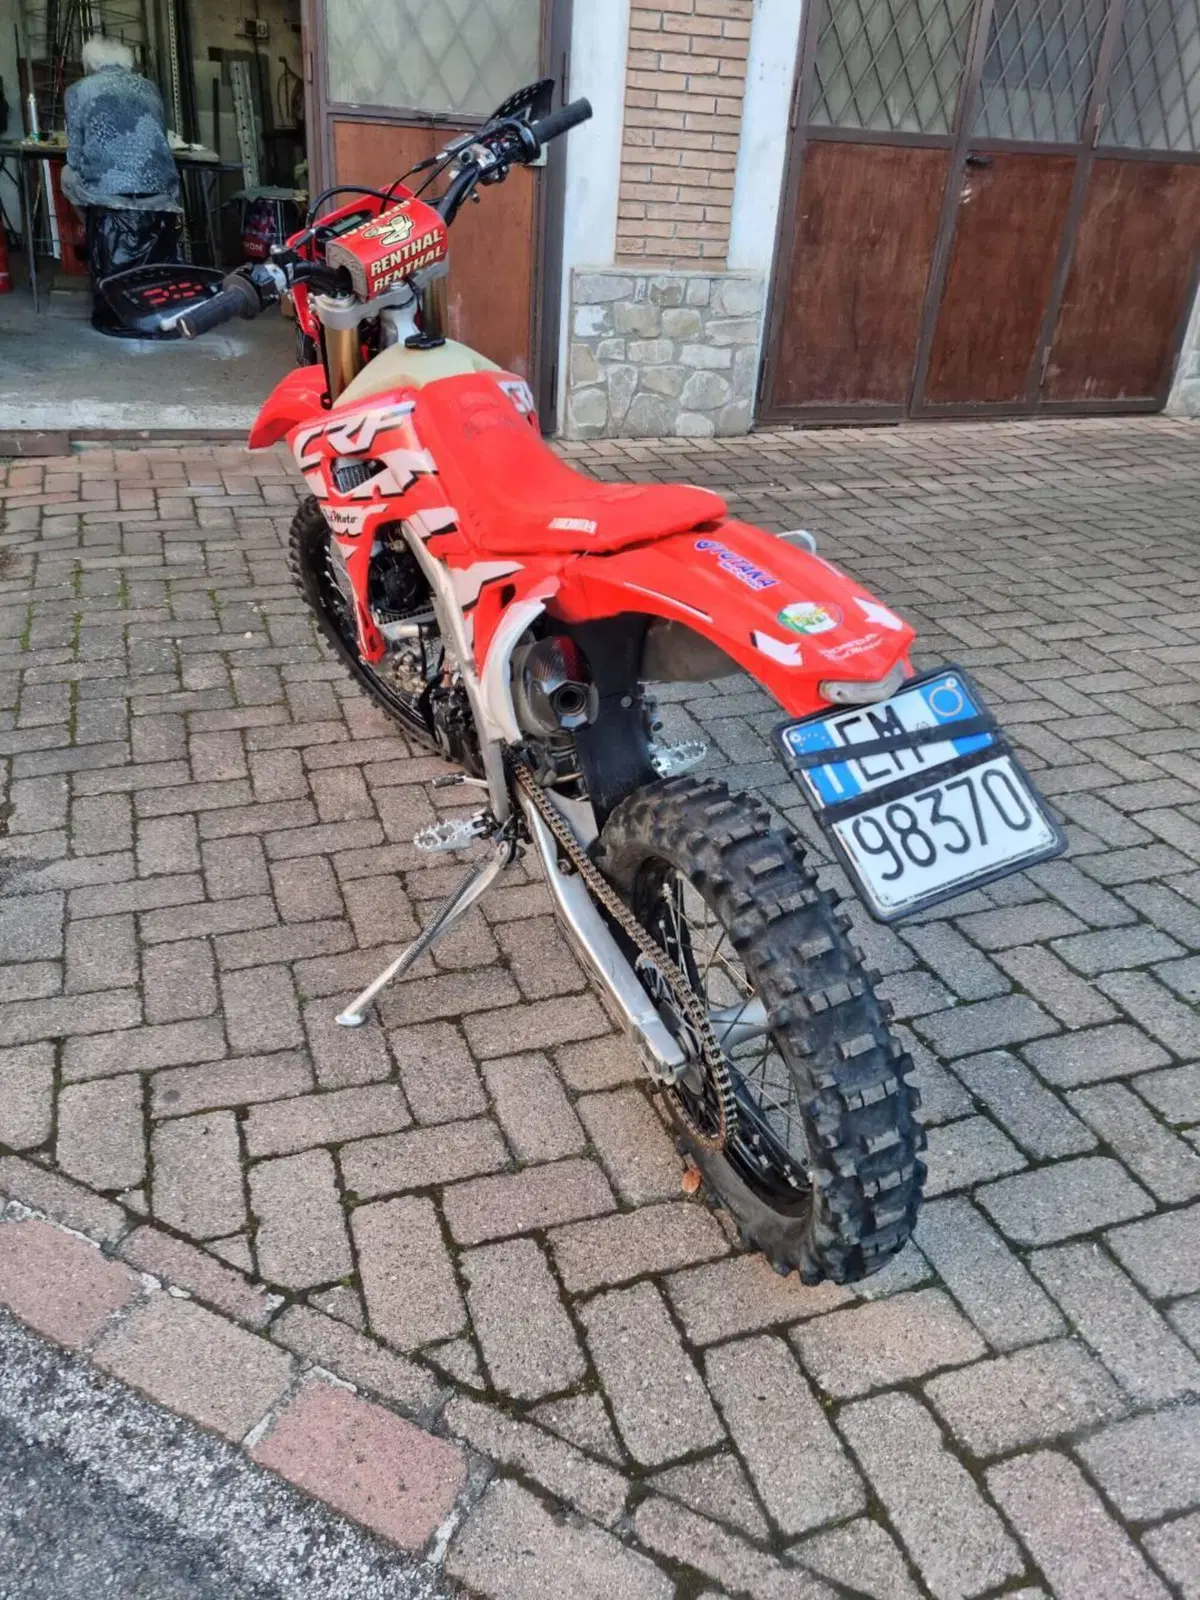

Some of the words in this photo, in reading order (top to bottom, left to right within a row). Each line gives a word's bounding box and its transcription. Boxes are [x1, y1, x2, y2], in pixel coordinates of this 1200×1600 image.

[370, 229, 443, 277] RENTHAL
[373, 246, 443, 293] RENTHAL
[852, 768, 1032, 881] 98370
